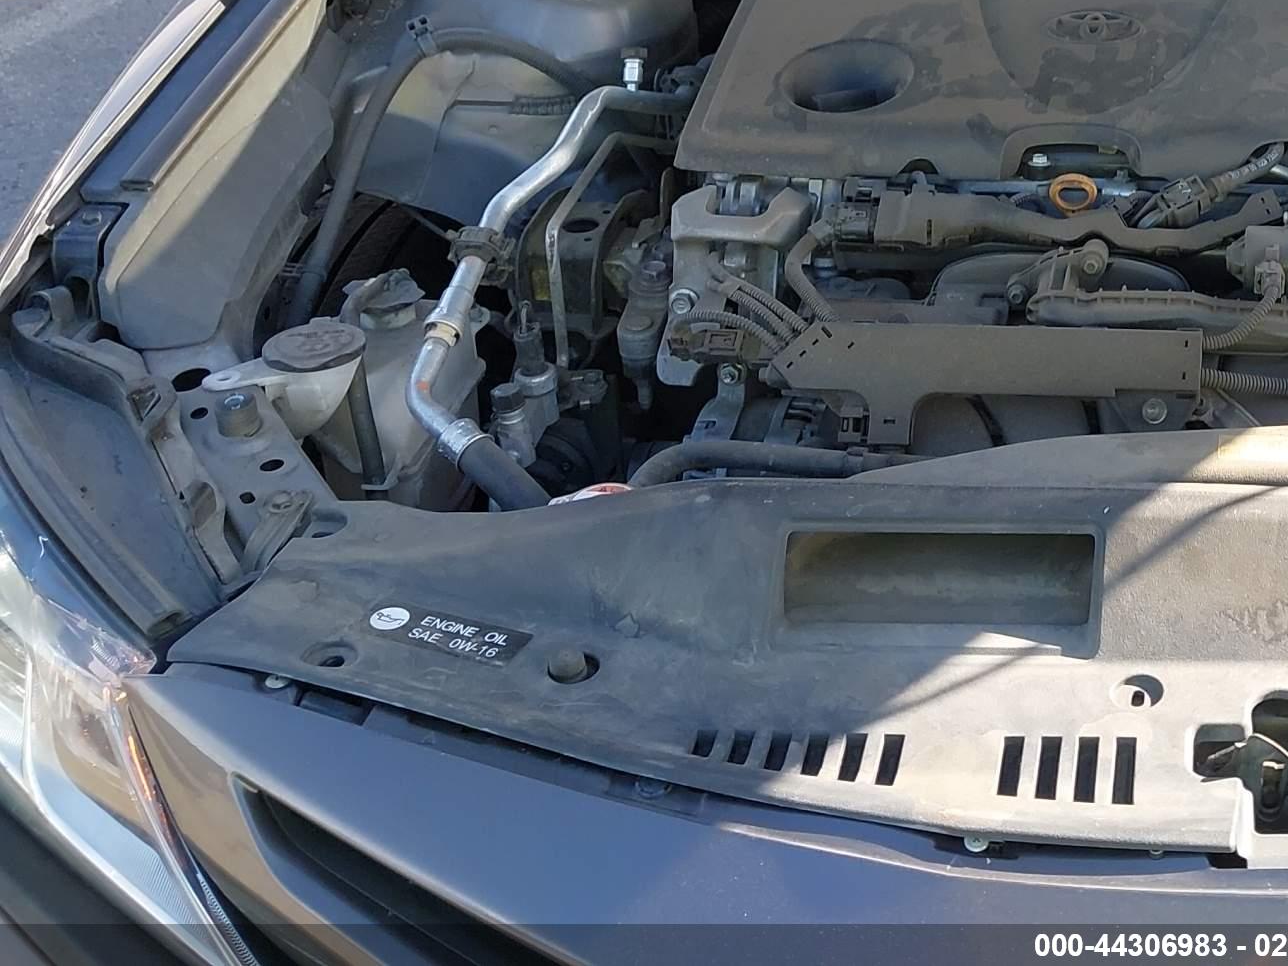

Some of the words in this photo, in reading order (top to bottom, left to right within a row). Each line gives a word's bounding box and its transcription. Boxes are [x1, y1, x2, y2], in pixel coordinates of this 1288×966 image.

[408, 627, 443, 645] SAE
[448, 638, 498, 658] 0W-16
[420, 616, 480, 637] ENGINE
[484, 631, 508, 646] OIL
